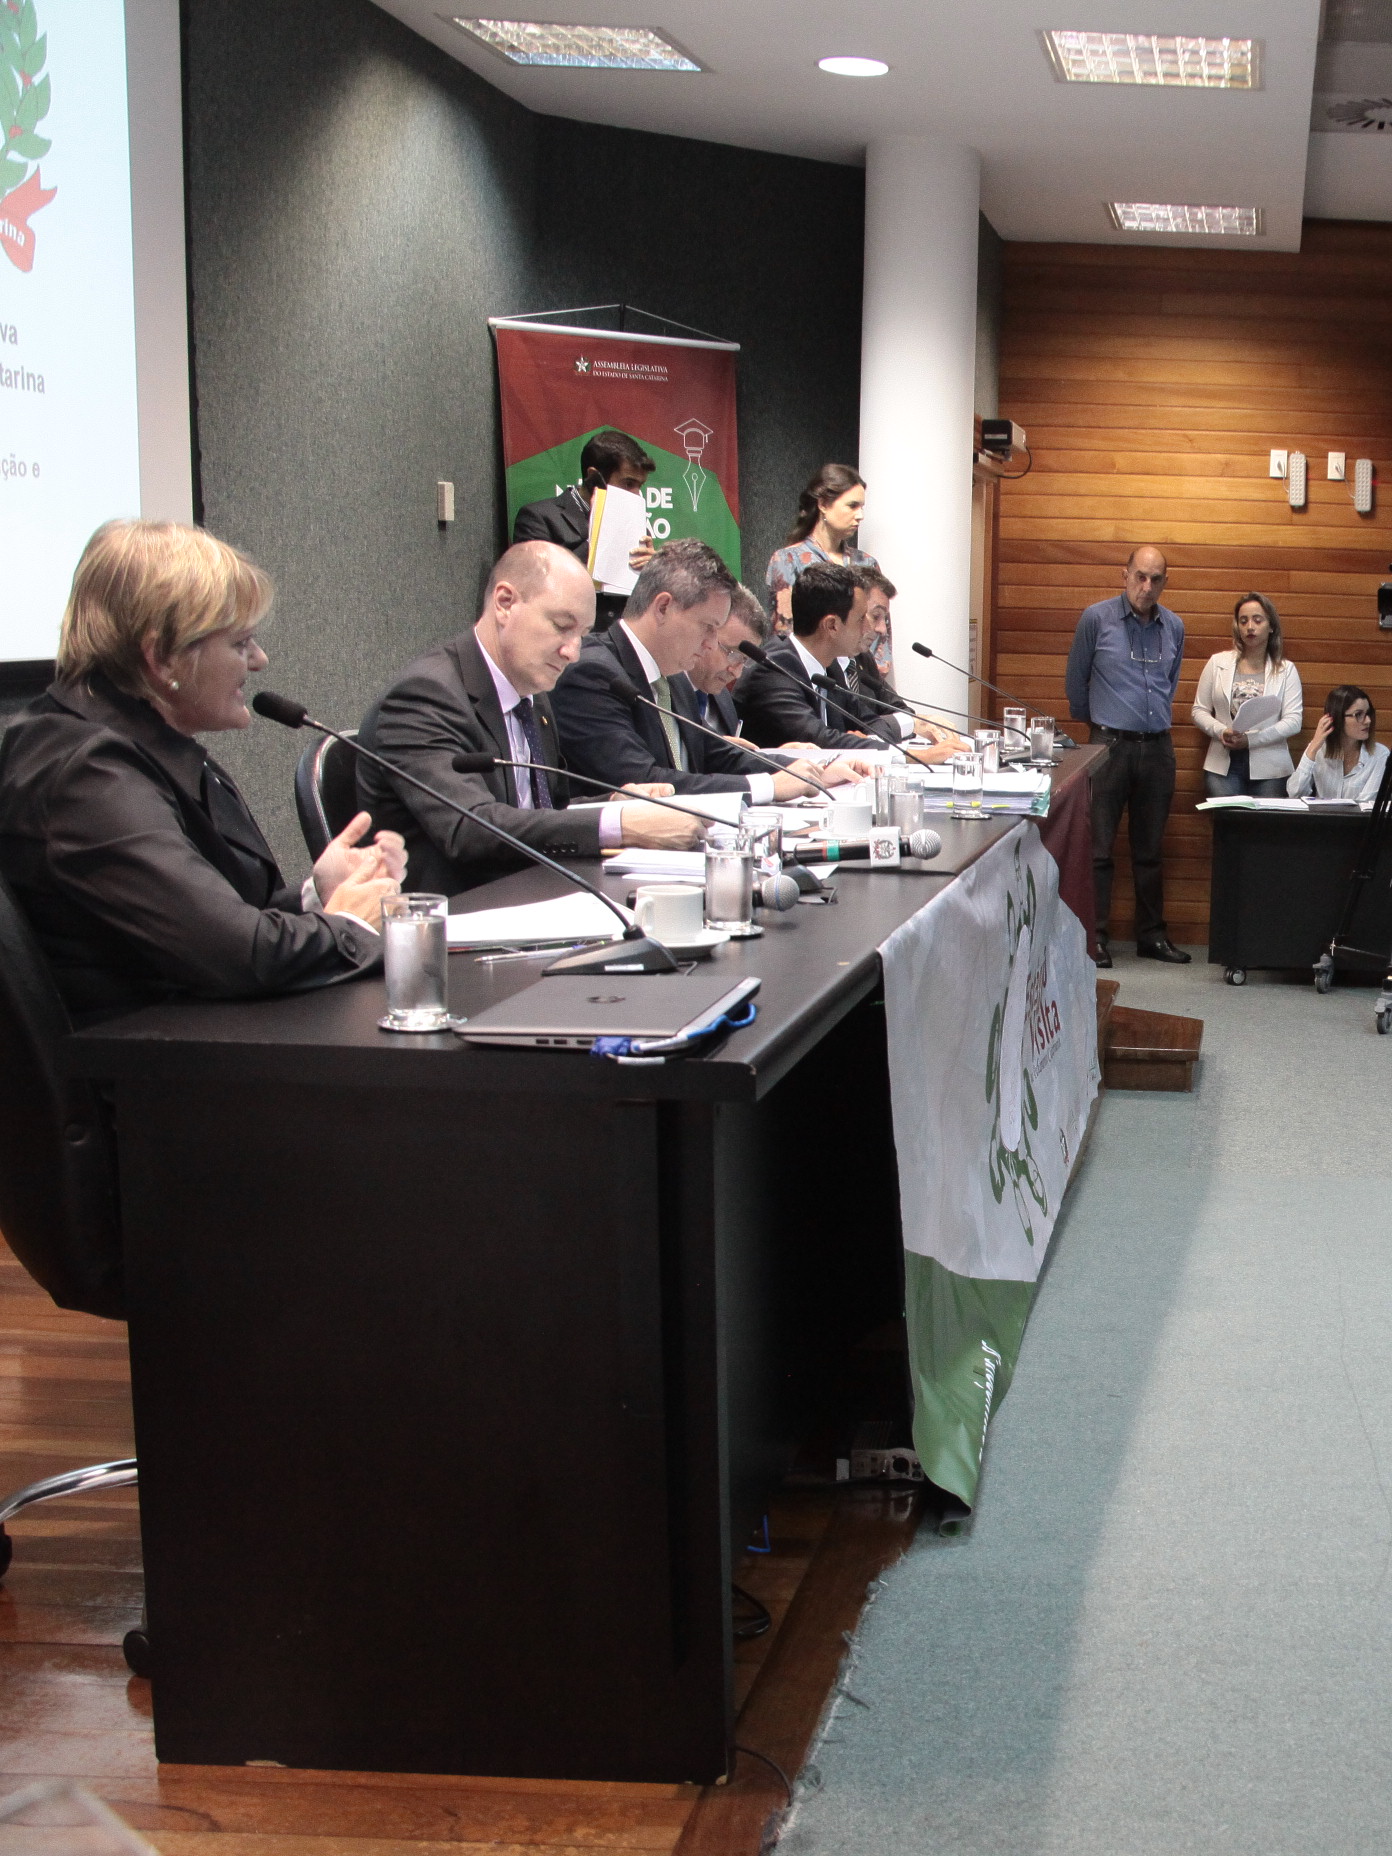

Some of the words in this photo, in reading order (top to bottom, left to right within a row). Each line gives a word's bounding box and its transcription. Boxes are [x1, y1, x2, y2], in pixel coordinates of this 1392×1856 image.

[593, 360, 630, 370] ASSEMBLEIA
[631, 363, 668, 373] LEGISLATIVA
[32, 462, 41, 479] e
